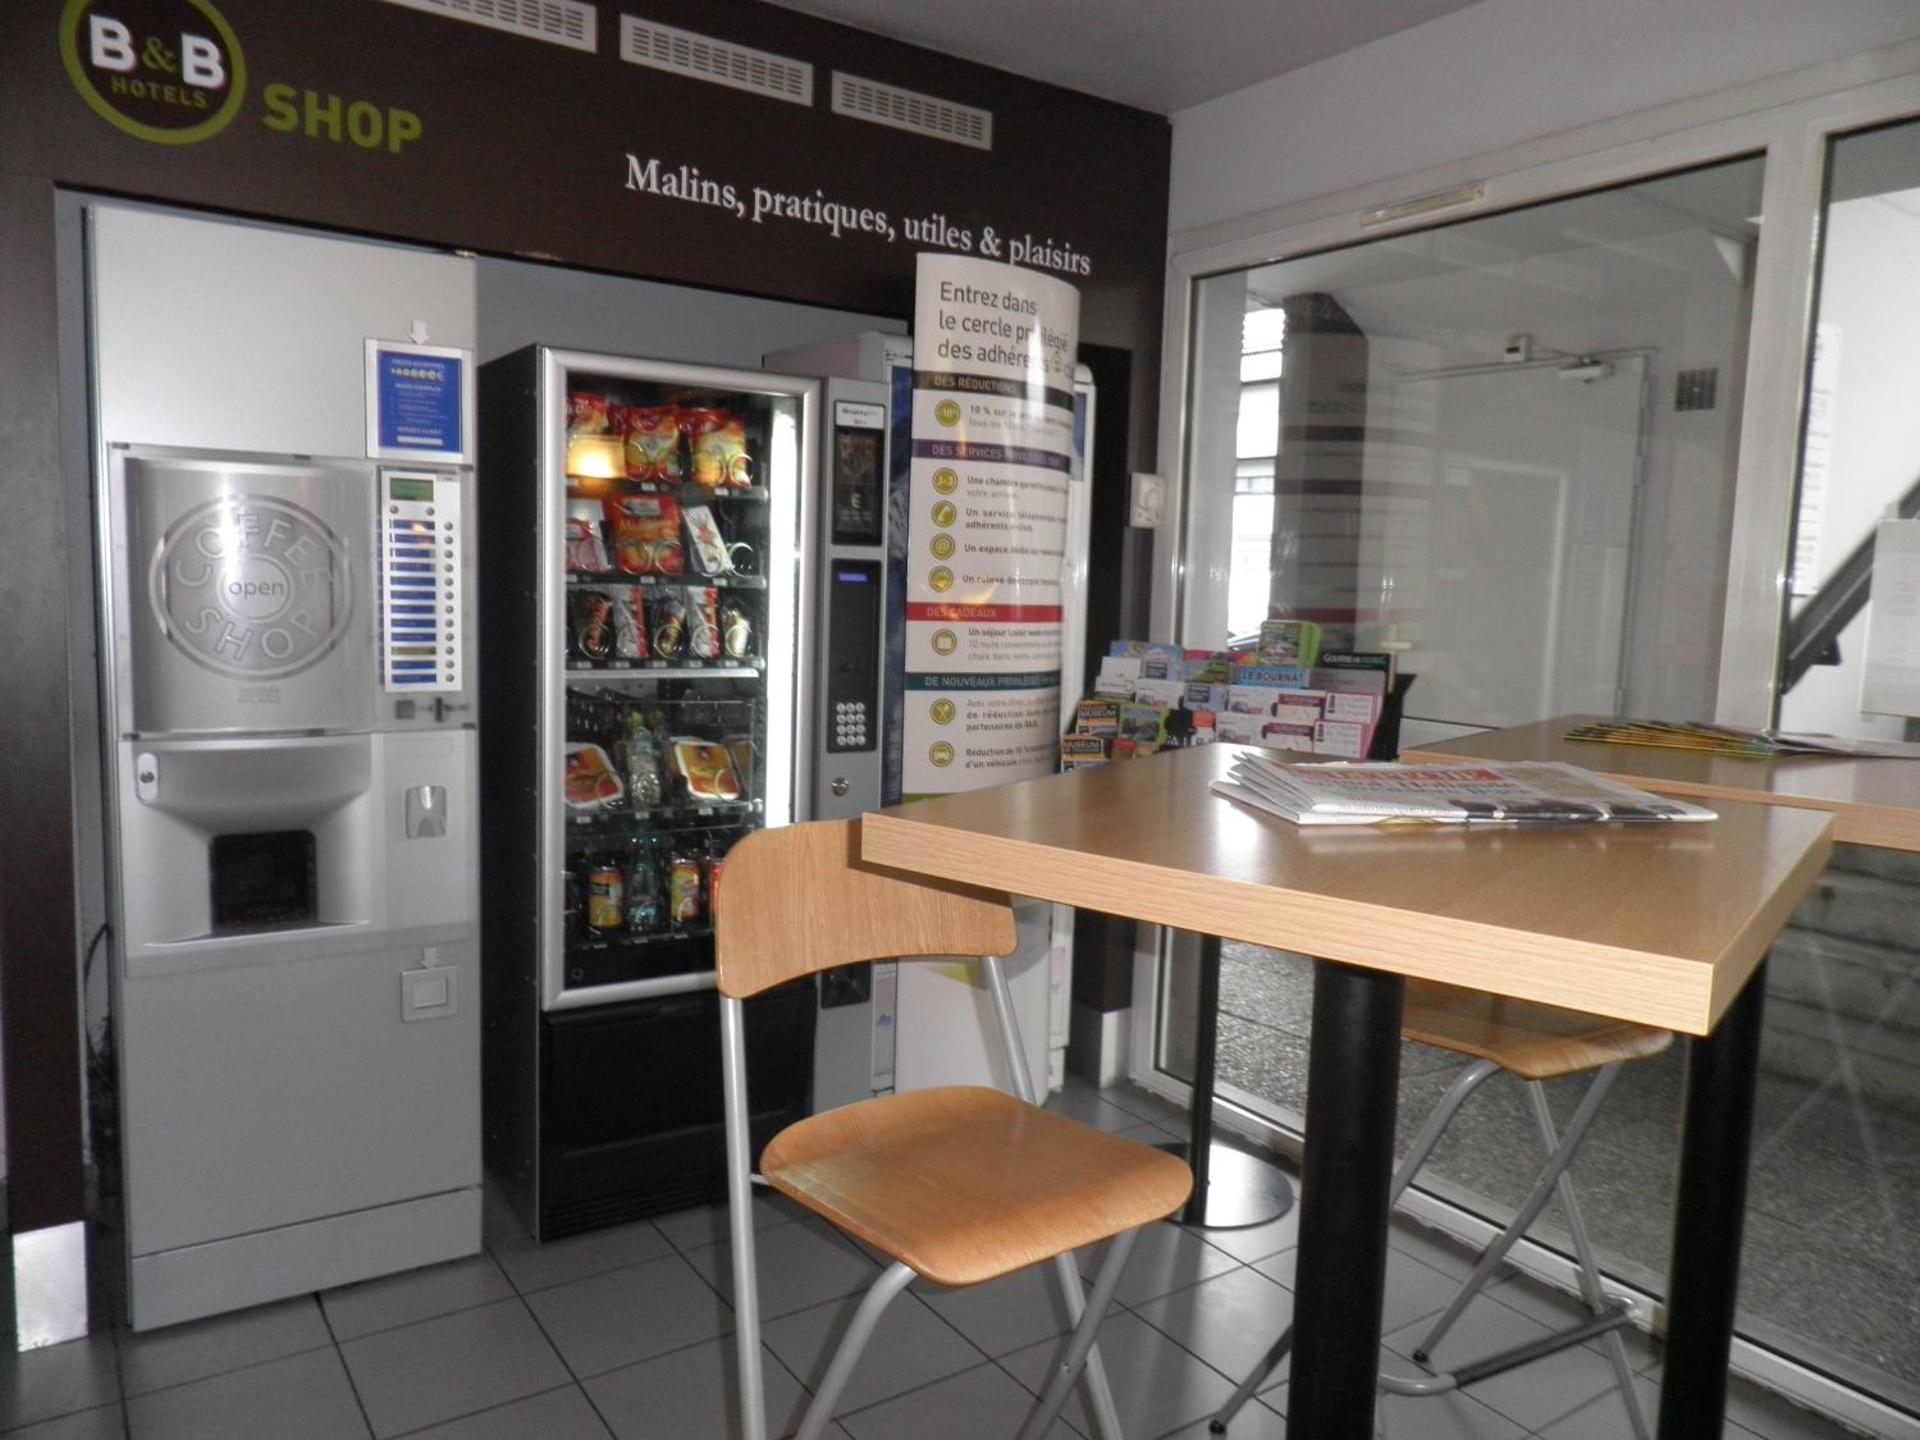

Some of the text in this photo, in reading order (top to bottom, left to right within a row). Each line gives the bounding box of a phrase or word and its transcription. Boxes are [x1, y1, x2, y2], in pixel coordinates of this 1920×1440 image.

[110, 76, 208, 109] HOTELS
[261, 82, 423, 153] SHOP
[624, 154, 1091, 276] Malins, pratiques, utiles & plaisirs
[940, 281, 1038, 316] Entrez dans
[938, 309, 956, 331] le
[962, 316, 1012, 338] cercle
[937, 338, 972, 360] des
[934, 375, 955, 388] DES
[932, 445, 953, 457] DES
[955, 446, 1002, 459] SERVICES
[967, 476, 984, 485] Une
[966, 508, 979, 517] Un
[964, 543, 977, 552] Un
[962, 574, 974, 583] Un
[229, 581, 285, 599] open
[926, 607, 996, 618] DES CADEAUX
[185, 607, 320, 661] SHOP
[968, 628, 980, 636] Un
[925, 676, 938, 687] DE
[942, 676, 995, 688] NOUVEAUX
[966, 711, 978, 719] de
